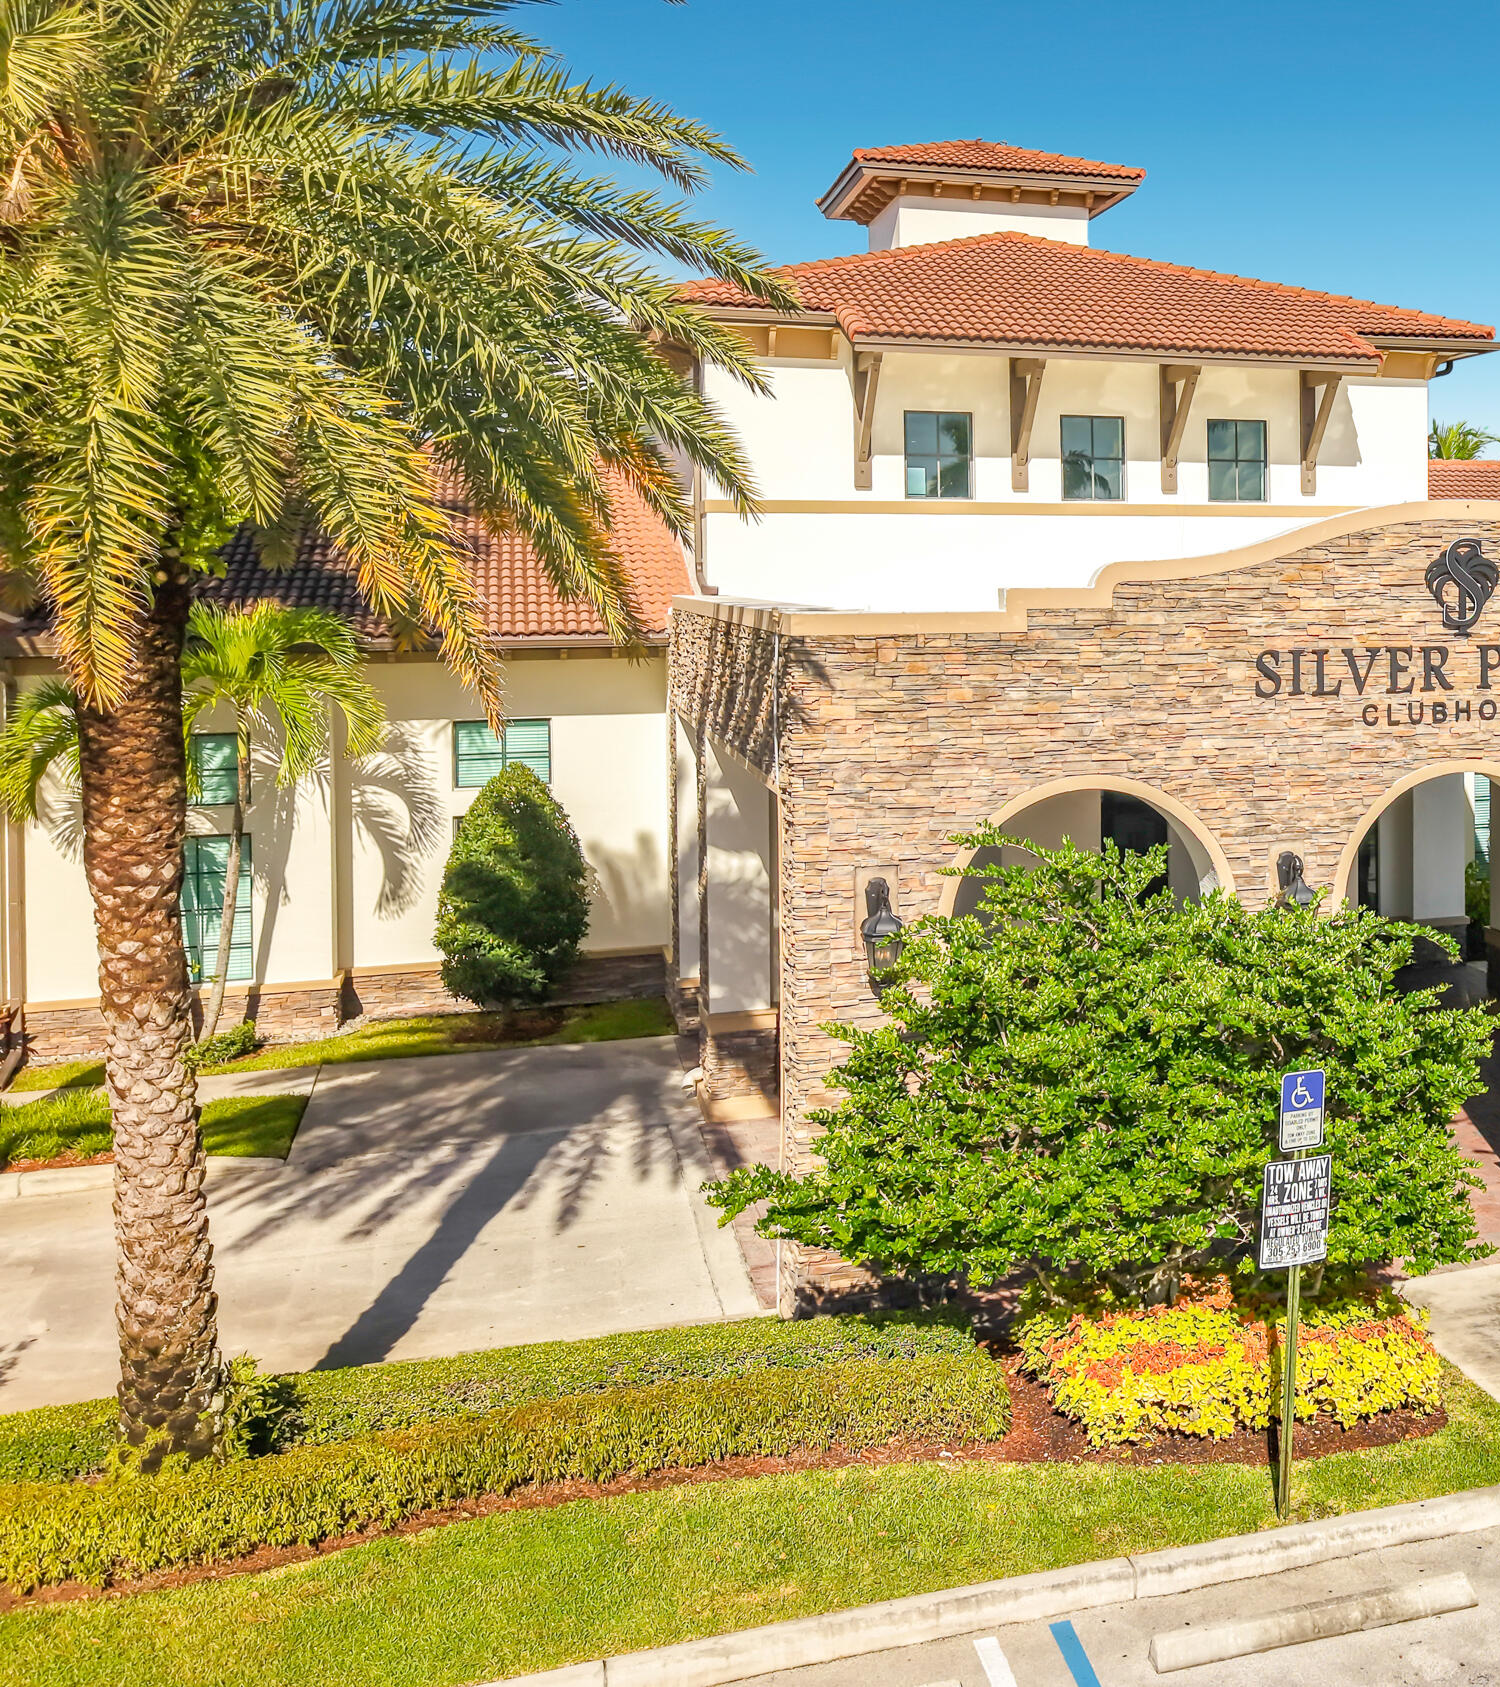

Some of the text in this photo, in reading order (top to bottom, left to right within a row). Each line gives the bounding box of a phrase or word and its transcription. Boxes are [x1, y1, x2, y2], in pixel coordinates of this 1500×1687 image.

[1254, 645, 1454, 698] SILVER
[1268, 1158, 1328, 1185] TOW AWAY
[1270, 1185, 1278, 1195] 24
[1283, 1180, 1313, 1203] ZONE
[1265, 1203, 1300, 1217] UNAUTHORIZED
[1301, 1199, 1321, 1212] VEHICLES
[1267, 1208, 1326, 1228] VESSELS WILL BE TOWED
[1269, 1220, 1322, 1238] AT OWNER'S EXPENSE
[1266, 1231, 1323, 1248] REGULATED TOWING
